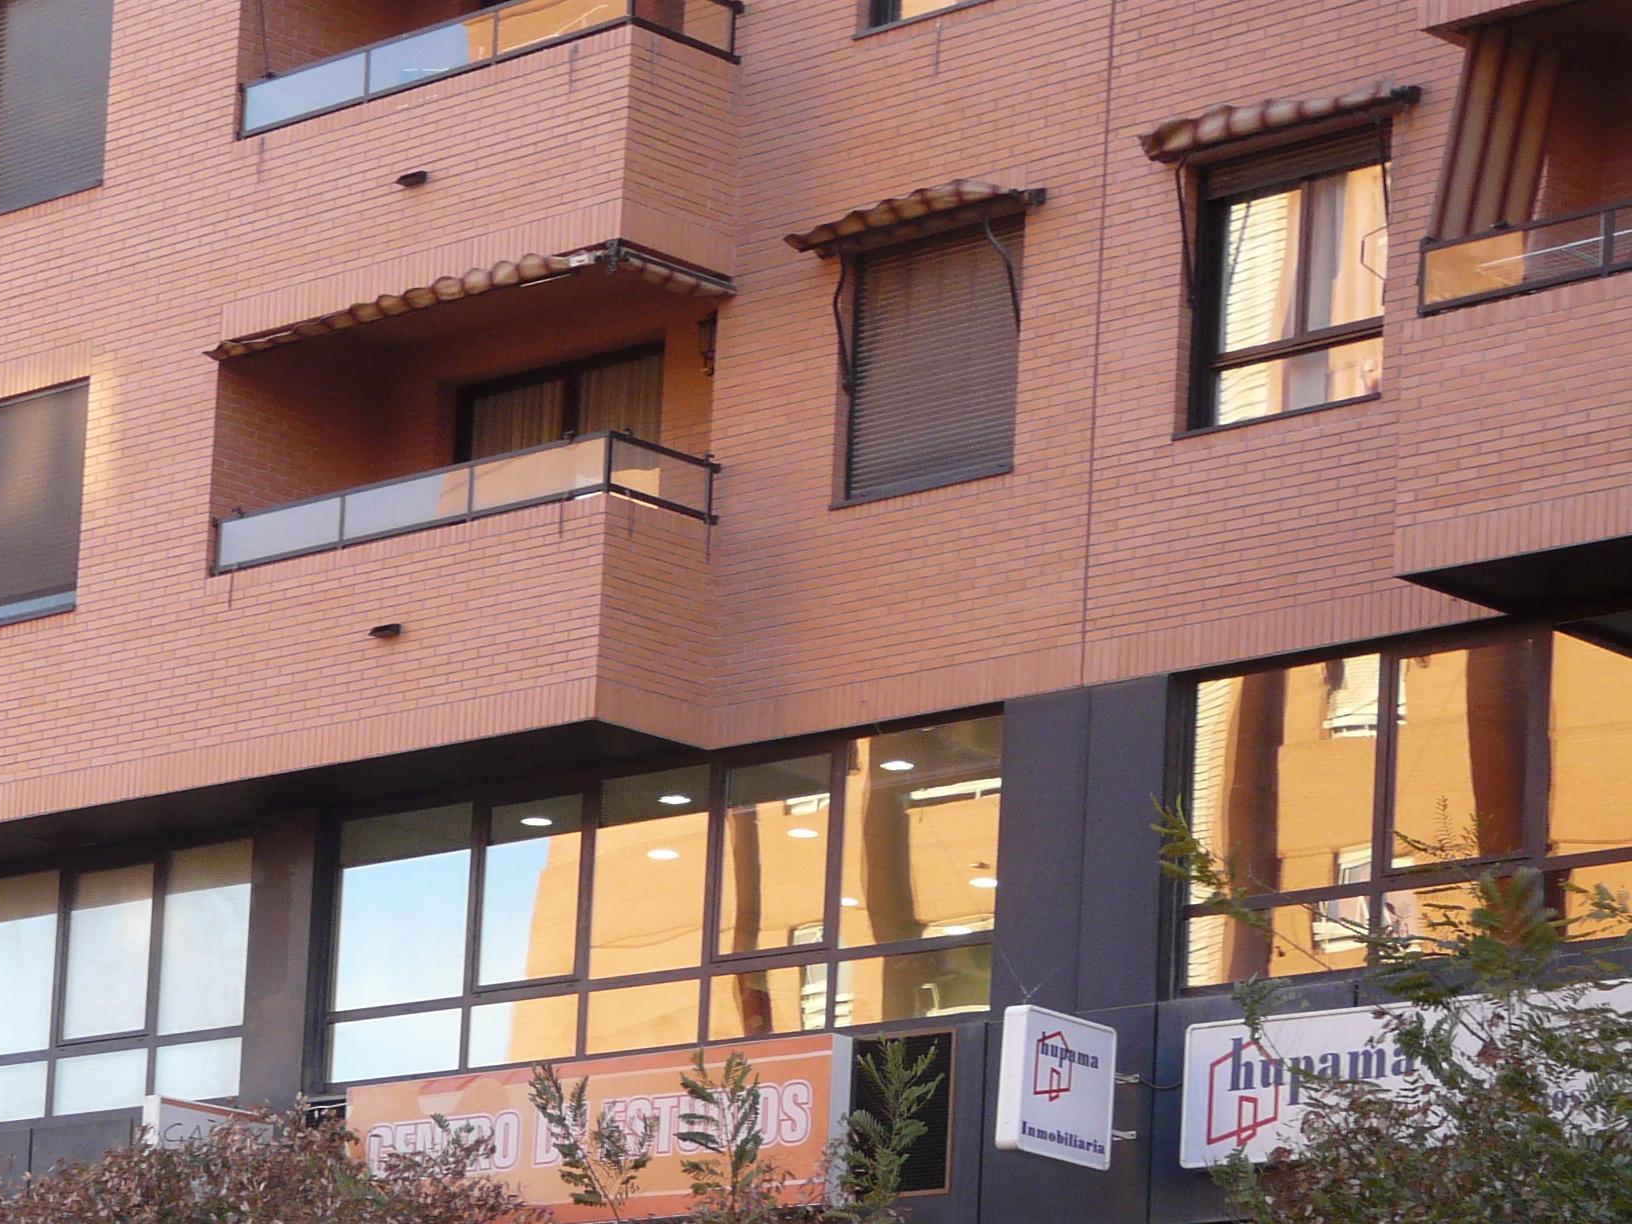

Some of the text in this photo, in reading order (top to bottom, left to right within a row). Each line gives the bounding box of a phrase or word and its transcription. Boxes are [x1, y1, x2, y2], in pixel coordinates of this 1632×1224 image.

[1041, 1032, 1099, 1069] hupama
[1228, 1037, 1415, 1106] hupama
[1021, 1121, 1105, 1155] Inmobiliaria
